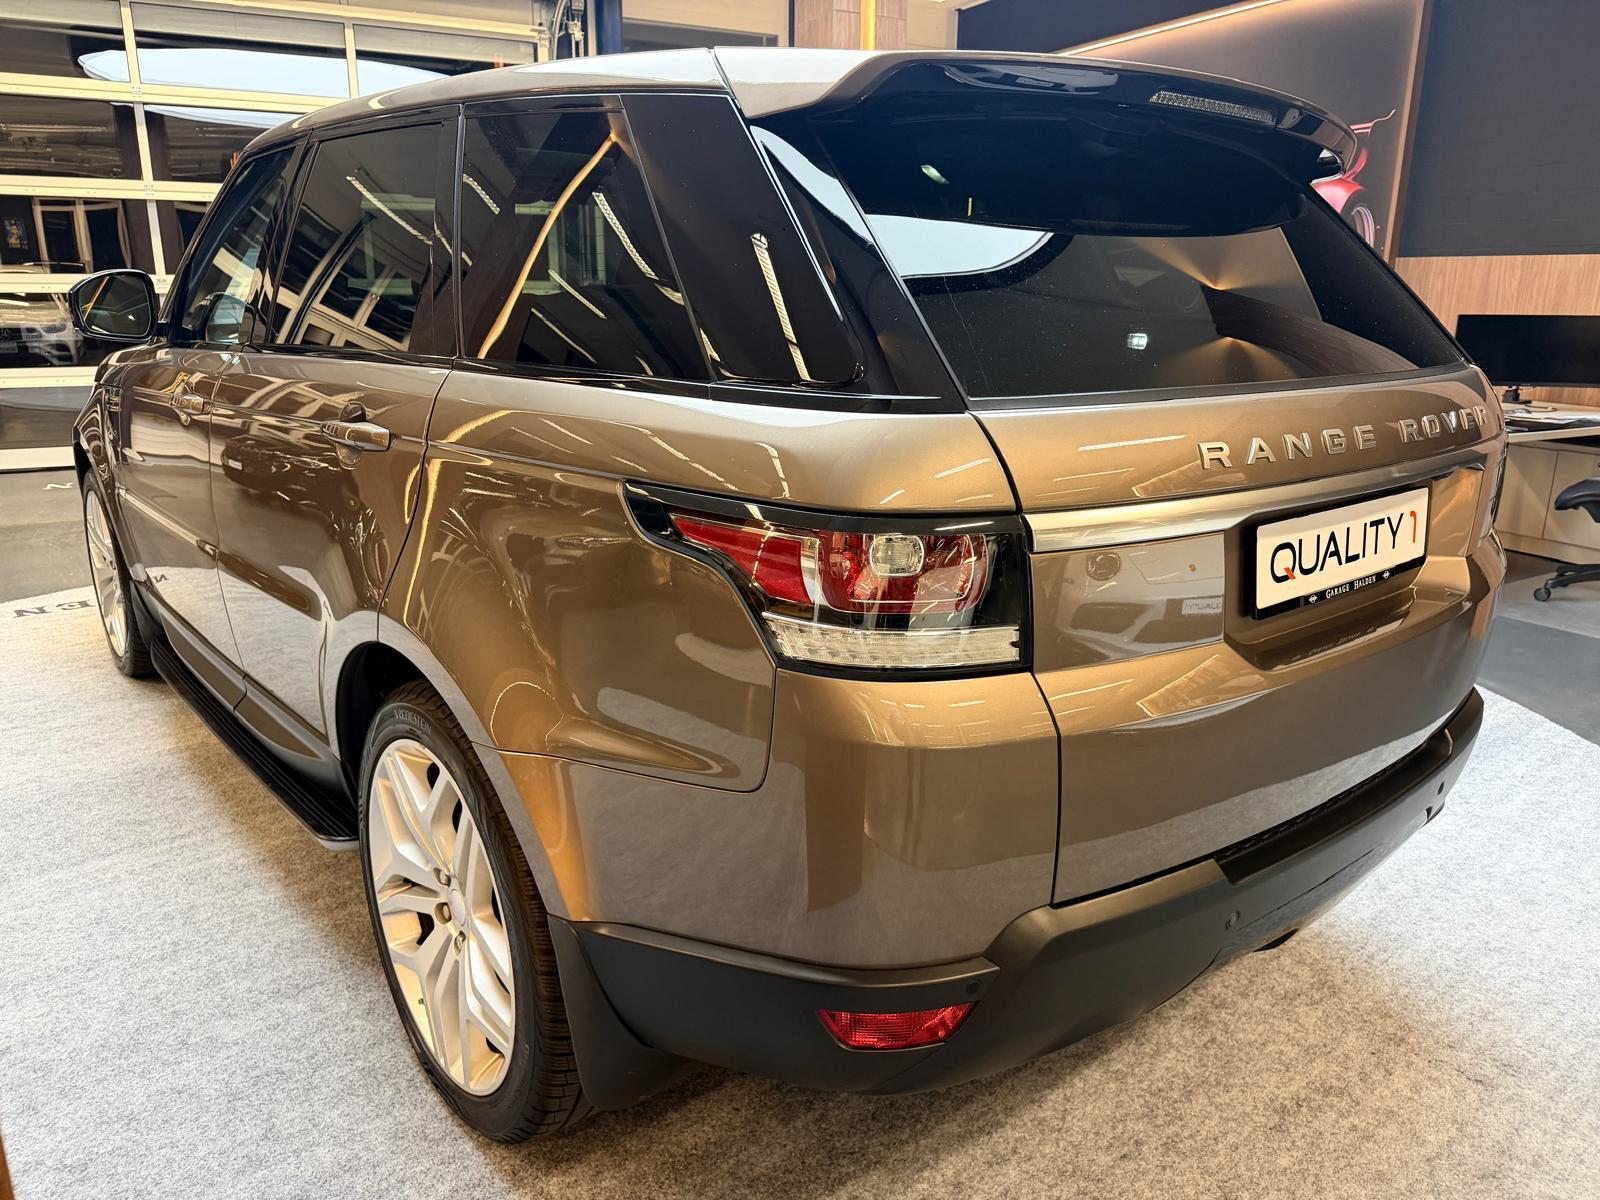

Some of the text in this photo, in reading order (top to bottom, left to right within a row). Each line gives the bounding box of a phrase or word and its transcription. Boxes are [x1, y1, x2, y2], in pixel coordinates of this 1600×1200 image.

[1197, 404, 1488, 469] RANGE ROVER
[1270, 510, 1418, 583] QUALITY 1
[1325, 575, 1377, 599] GARAGE HALDEN
